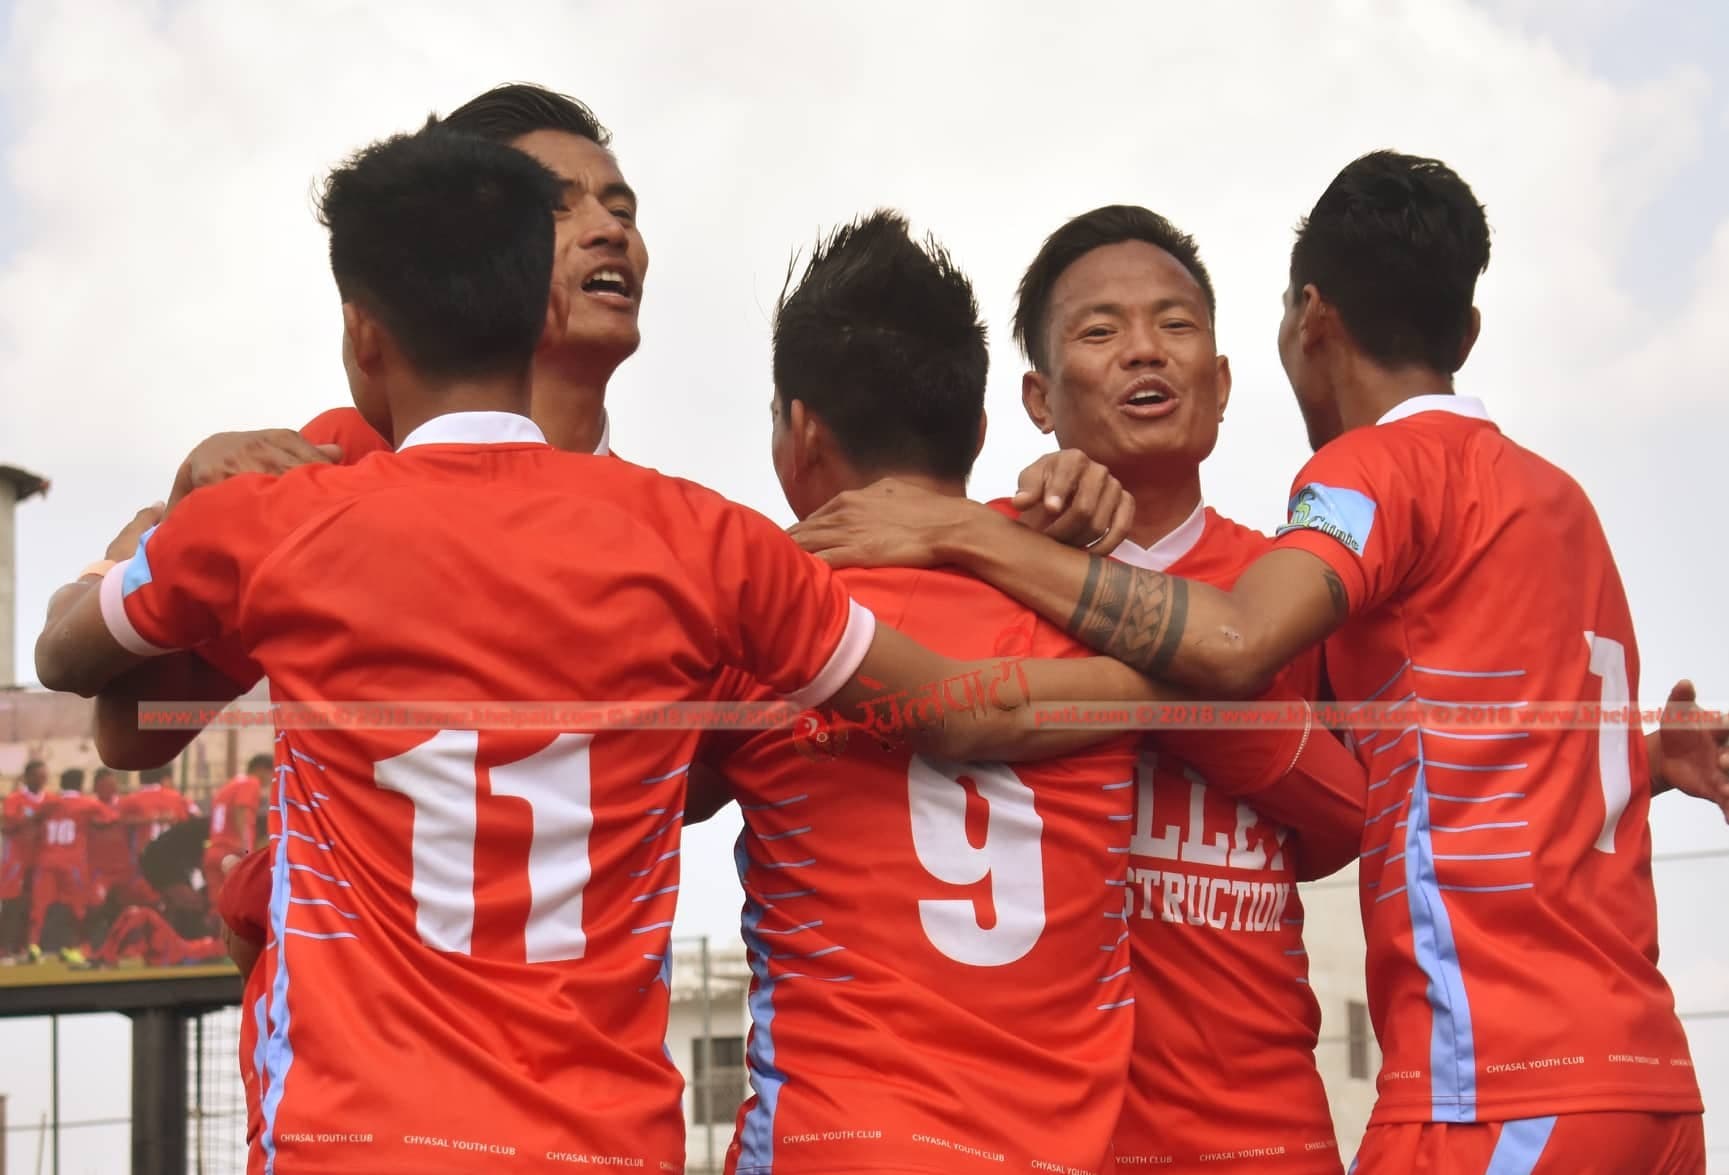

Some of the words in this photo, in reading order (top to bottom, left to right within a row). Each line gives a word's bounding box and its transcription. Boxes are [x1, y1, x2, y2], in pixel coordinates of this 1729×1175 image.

[374, 729, 596, 963] 11
[908, 753, 1046, 967] 9
[1486, 1062, 1527, 1074] CHYASAL
[1529, 1058, 1561, 1070] YOUTH
[1562, 1056, 1585, 1066] CLUB
[1400, 1071, 1421, 1080] CLUB
[280, 1134, 316, 1144] CHYASAL
[317, 1134, 347, 1143] YOUTH
[349, 1134, 374, 1143] CLUB
[404, 1135, 449, 1148] CHYASAL
[452, 1139, 488, 1152] YOUTH
[489, 1144, 516, 1156] CLUB
[783, 1134, 820, 1145] CHYASAL
[822, 1131, 854, 1142] YOUTH
[856, 1130, 882, 1140] CLUB
[912, 1133, 952, 1149] CHYASAL
[953, 1142, 982, 1157] YOUTH
[982, 1150, 1006, 1162] CLUB
[1199, 1151, 1236, 1162] CHYASAL
[1237, 1148, 1265, 1159] YOUTH
[1265, 1145, 1286, 1156] CLUB
[546, 1151, 590, 1163] CHYASAL
[591, 1155, 623, 1166] YOUTH
[624, 1158, 645, 1168] CLUB
[1031, 1159, 1066, 1174] CHYASAL
[1115, 1155, 1147, 1165] YOUTH
[1149, 1155, 1173, 1164] CLUB
